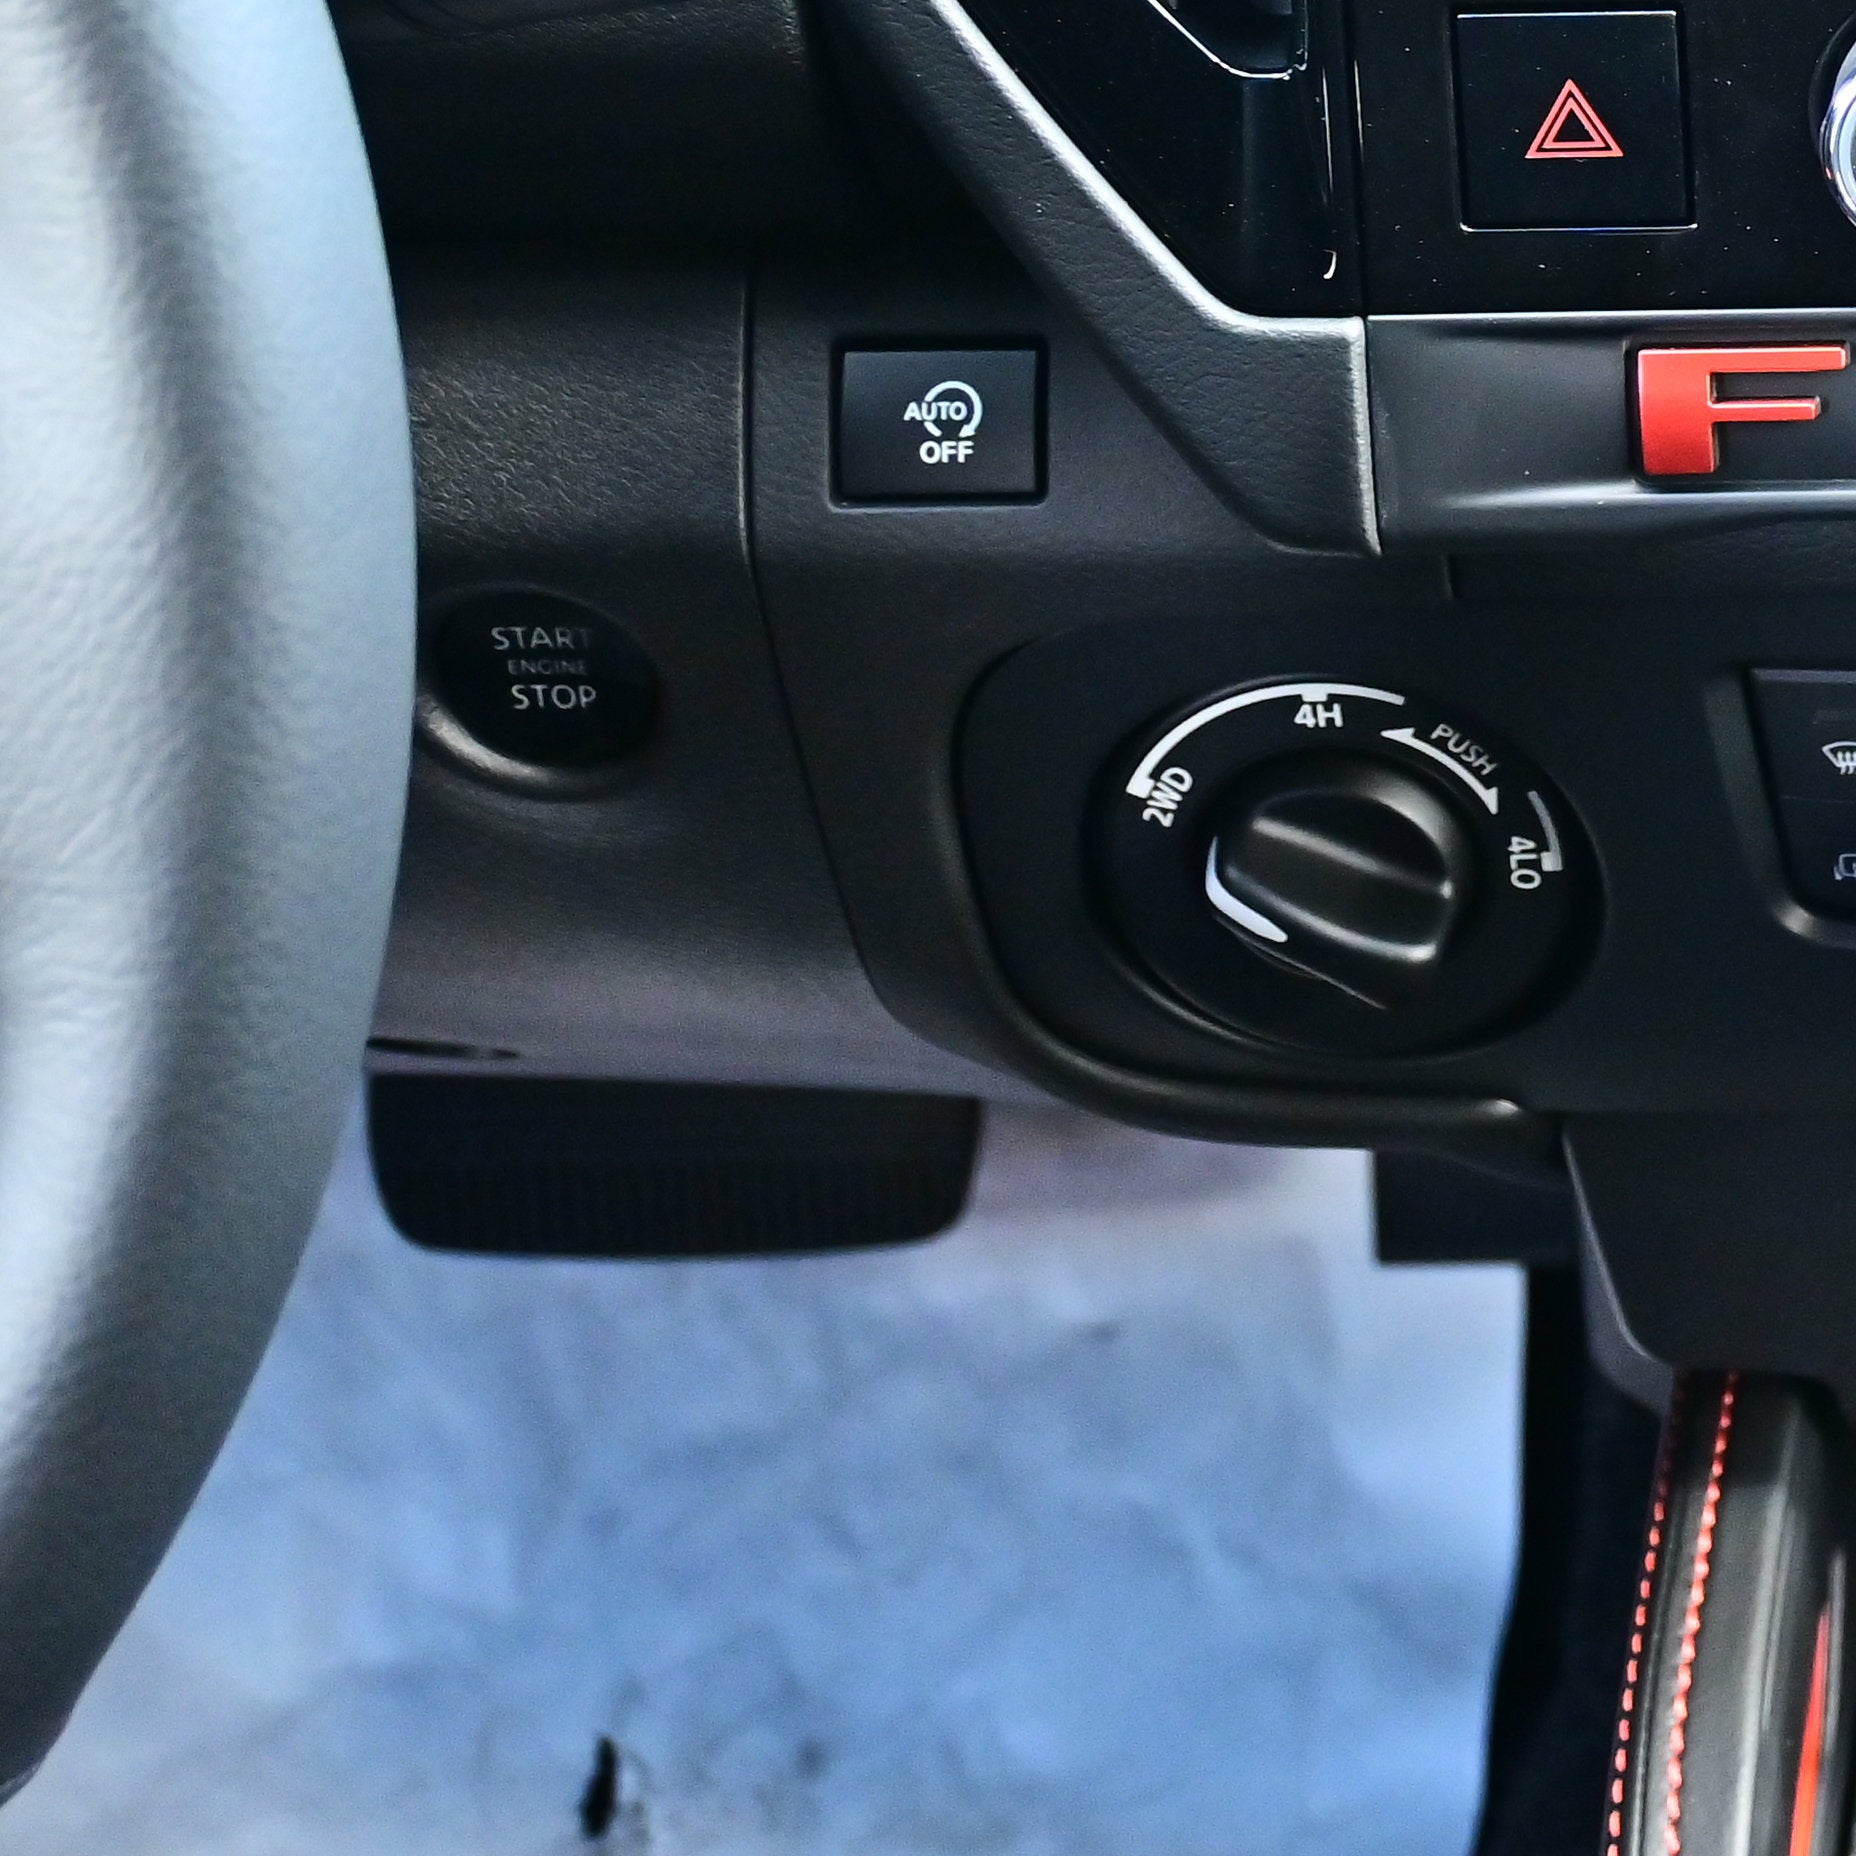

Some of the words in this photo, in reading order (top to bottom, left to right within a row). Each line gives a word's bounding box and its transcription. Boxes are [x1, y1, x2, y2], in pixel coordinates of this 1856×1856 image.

[903, 400, 969, 422] AUTO
[919, 440, 975, 464] OFF
[490, 626, 590, 652] START
[510, 684, 598, 711] STOP
[1293, 700, 1343, 729] 4H
[1430, 723, 1500, 776] PUSH
[1143, 767, 1194, 828] 2WD
[1506, 835, 1542, 890] 4LO
